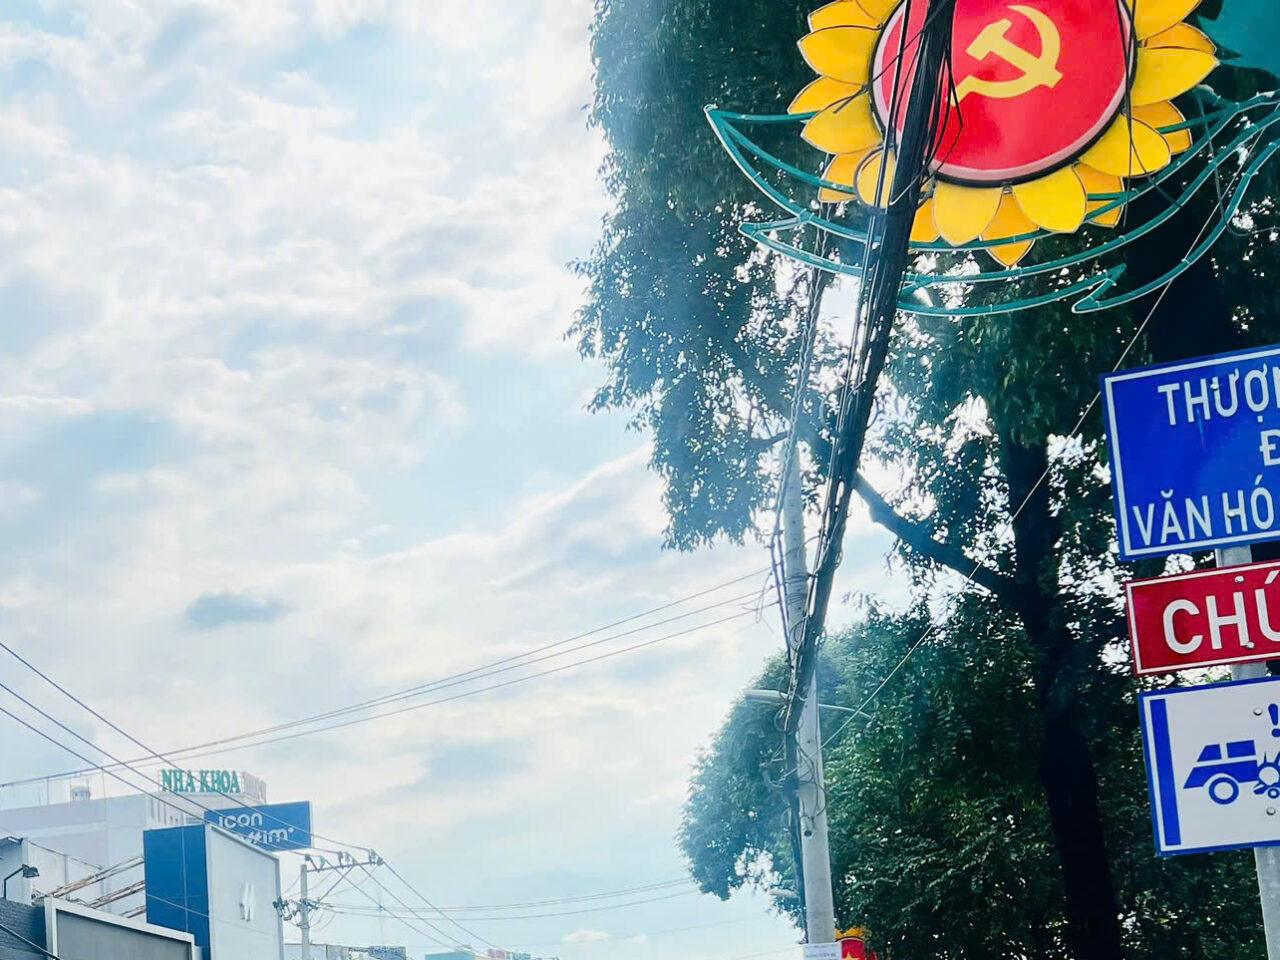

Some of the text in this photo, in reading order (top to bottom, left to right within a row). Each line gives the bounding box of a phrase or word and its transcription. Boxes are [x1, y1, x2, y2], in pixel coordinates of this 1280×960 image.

[1133, 474, 1275, 546] VĂN HÓ
[1163, 570, 1280, 654] CHÚ
[160, 770, 241, 793] NHA KHOA
